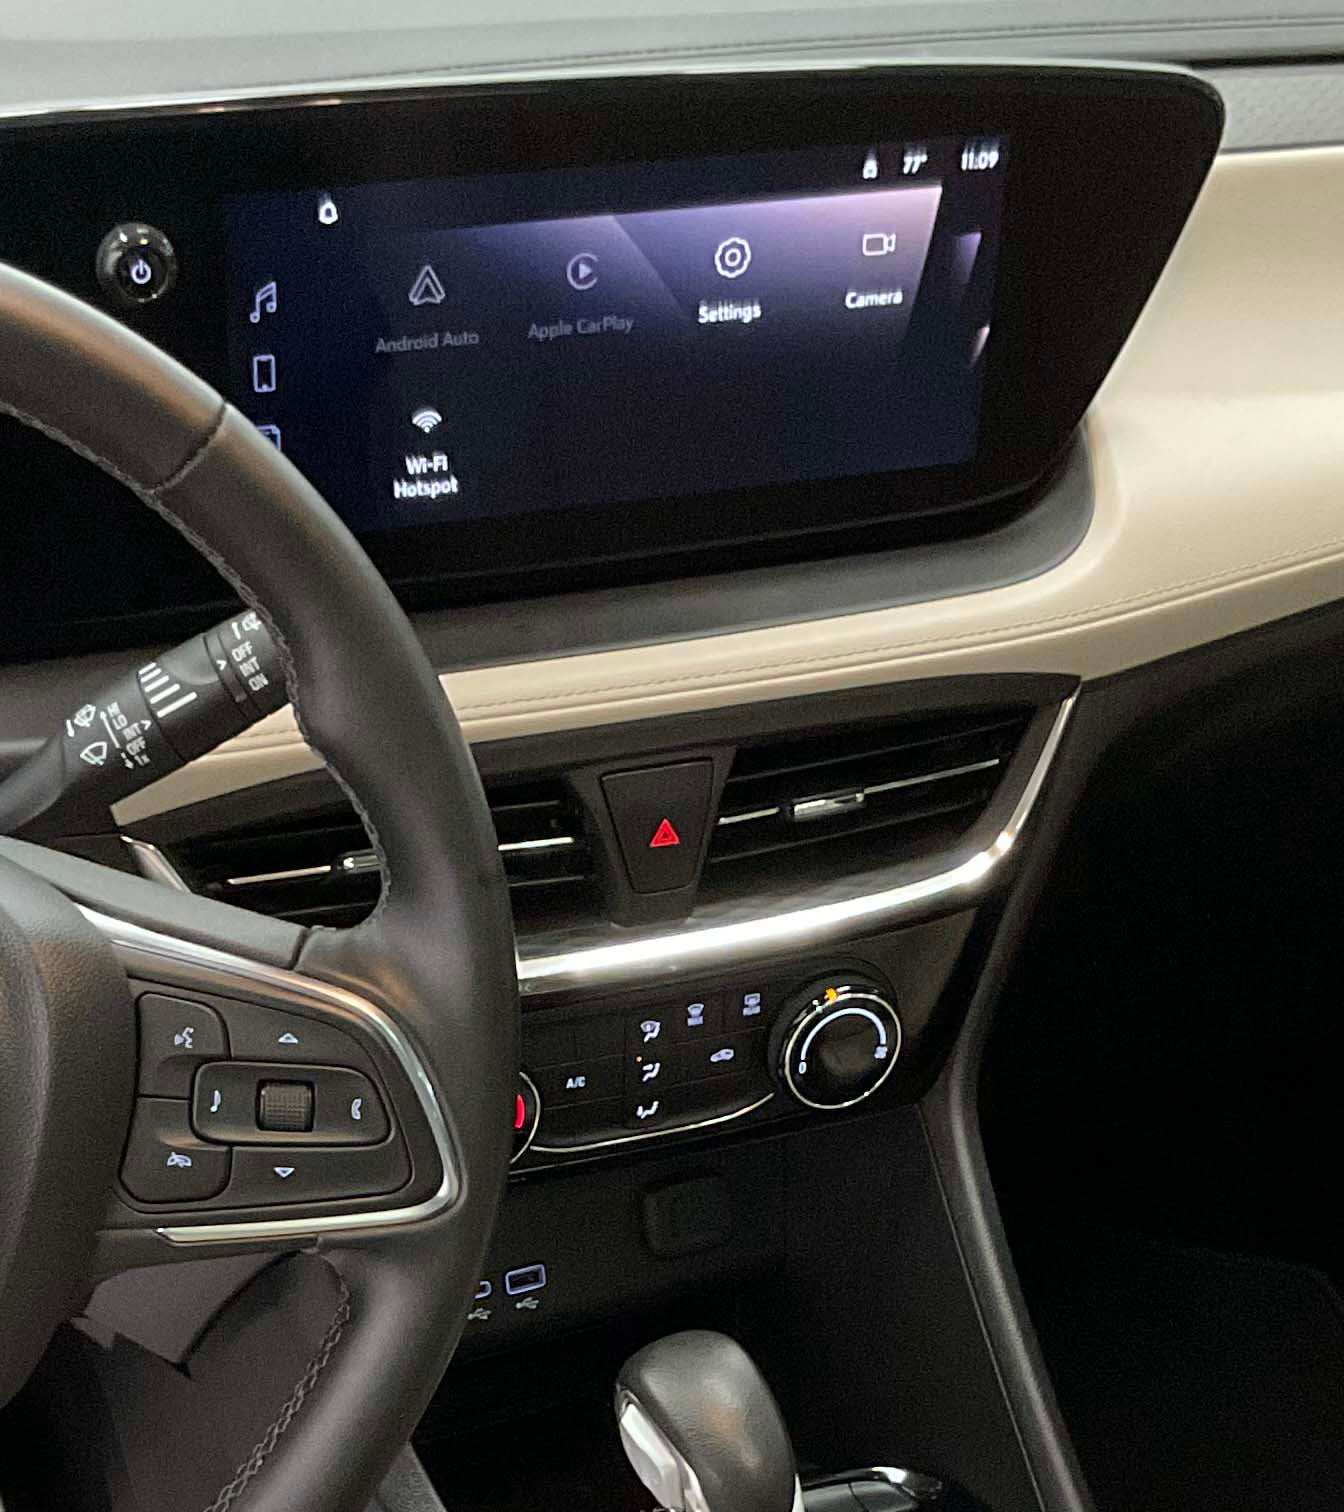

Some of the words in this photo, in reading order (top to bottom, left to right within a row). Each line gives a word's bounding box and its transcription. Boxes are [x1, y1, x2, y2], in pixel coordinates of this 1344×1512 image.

[961, 150, 1000, 172] 11:09
[845, 290, 904, 310] Camera
[698, 301, 762, 325] Settings
[527, 320, 573, 343] Apple
[576, 315, 635, 336] CarPlay
[374, 332, 439, 354] Android
[442, 330, 480, 348] Auto
[405, 452, 449, 475] Wi-Fi
[393, 475, 459, 500] Hotspot
[231, 641, 253, 662] OFF
[239, 659, 261, 678] INT
[248, 675, 269, 692] ON
[112, 715, 128, 731] LO
[123, 722, 142, 740] INT
[126, 738, 147, 756] OFF
[566, 1075, 586, 1090] A/C
